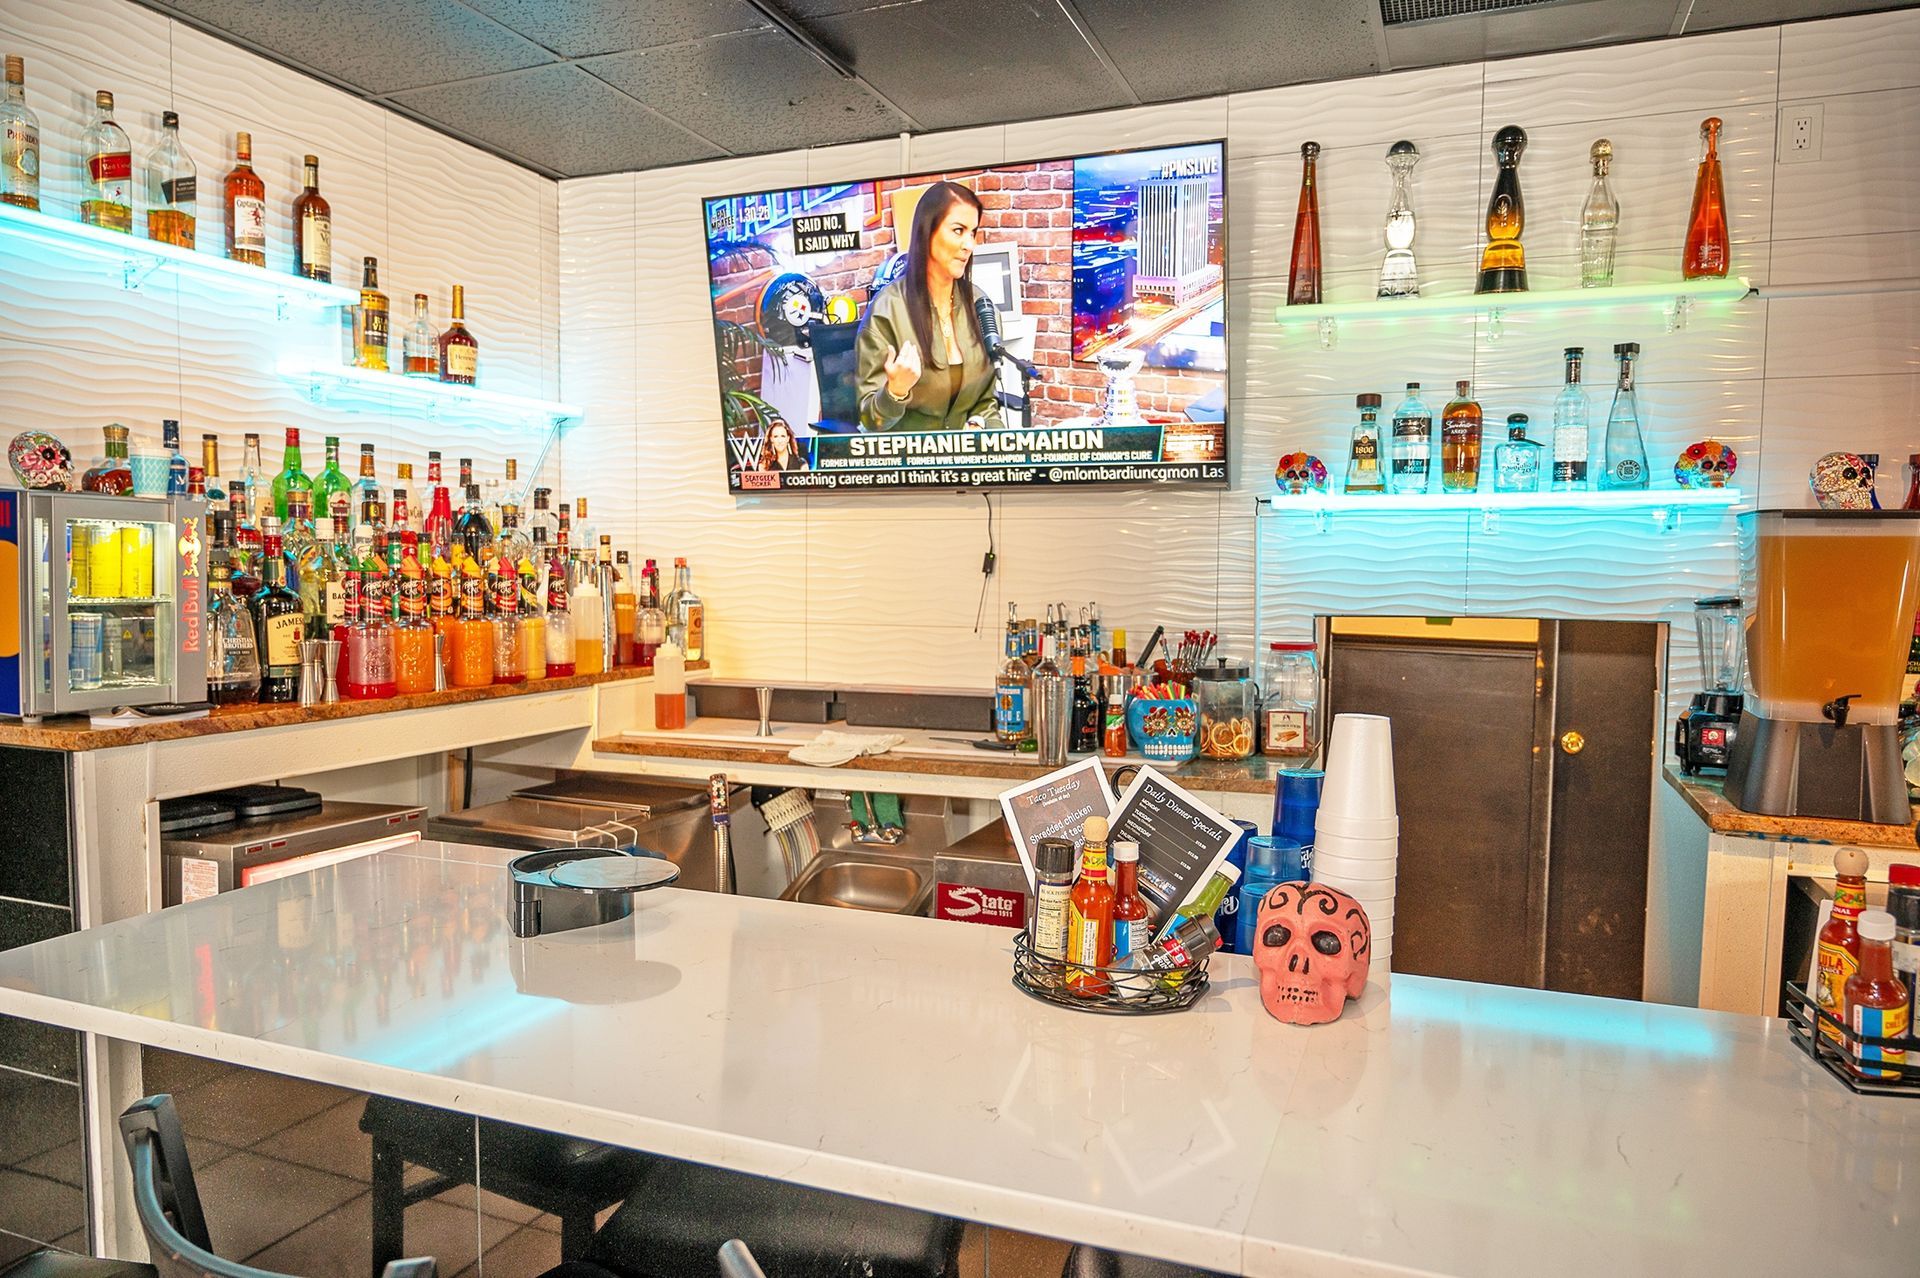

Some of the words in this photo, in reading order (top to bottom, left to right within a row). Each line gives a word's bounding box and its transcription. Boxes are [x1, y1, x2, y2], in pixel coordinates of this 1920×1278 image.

[1161, 157, 1218, 178] #PMSLIVE
[797, 219, 822, 232] SAID
[823, 217, 842, 230] NO.
[799, 239, 804, 251] I
[805, 237, 829, 250] SAID
[831, 234, 856, 248] WHY
[850, 433, 976, 456] STEPHANIE
[980, 429, 1104, 452] MCMAHON
[1355, 445, 1374, 454] 1800
[820, 458, 848, 467] FORMER
[849, 458, 865, 467] WWE
[865, 457, 903, 467] EXECUTIVE
[906, 456, 936, 465] FORMER
[936, 455, 954, 464] WWE
[988, 453, 1026, 463] CHAMPION
[1031, 452, 1079, 462] CO-FOUNDER
[1080, 452, 1090, 461] OF
[1091, 451, 1130, 461] CONNOR'S
[1131, 451, 1153, 460] CURE
[744, 474, 776, 483] SEATGEEK
[786, 472, 835, 488] coaching
[838, 474, 874, 485] career
[876, 471, 899, 484] and
[908, 469, 940, 484] think
[940, 469, 960, 482] it's
[961, 472, 970, 482] a
[971, 470, 1005, 486] great
[1048, 465, 1199, 482] @mlombardiuncgmon
[1202, 465, 1225, 478] Las
[182, 578, 200, 614] Bull
[182, 614, 200, 653] Red
[1026, 793, 1047, 806] Taco
[1047, 778, 1081, 797] Tuesday
[1141, 798, 1161, 813] MONDAY
[1144, 784, 1166, 804] Daily
[1165, 799, 1193, 820] Dinner
[1191, 816, 1222, 841] Specials
[1029, 820, 1064, 845] Shredded
[1064, 804, 1093, 826] chicken
[1134, 808, 1153, 823] TUESDAY
[1126, 819, 1152, 838] WEDNESDAY
[944, 886, 1013, 917] State
[981, 907, 998, 916] Since
[999, 909, 1013, 918] 1911
